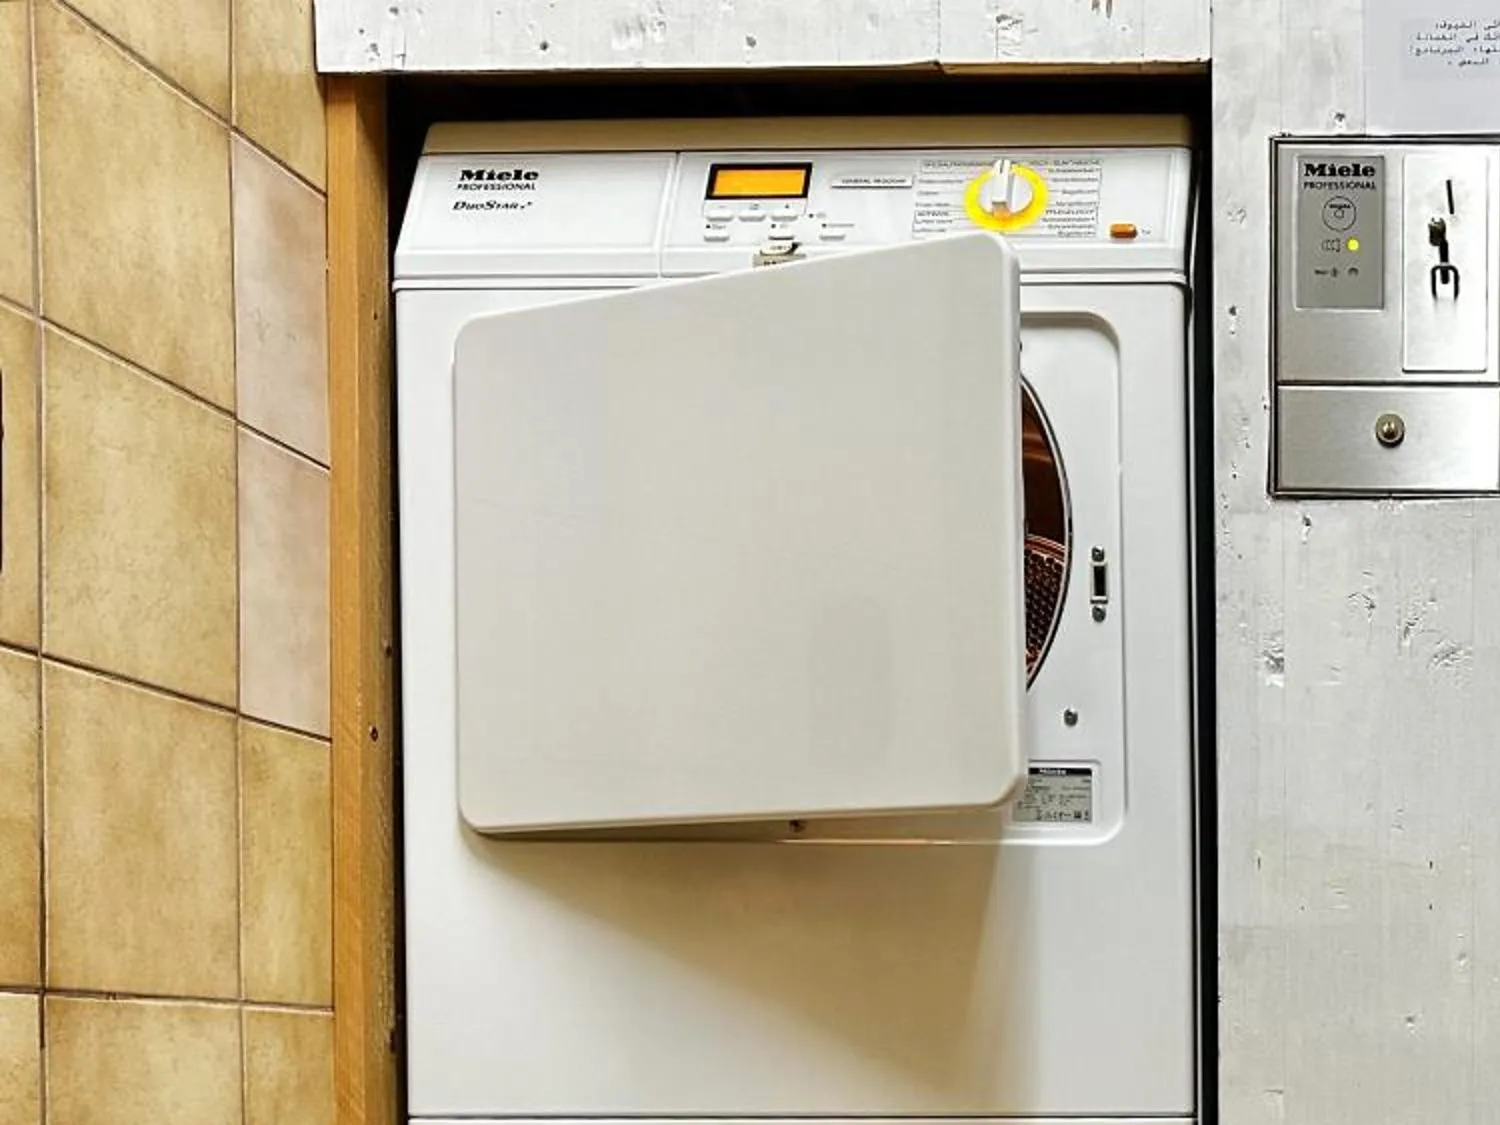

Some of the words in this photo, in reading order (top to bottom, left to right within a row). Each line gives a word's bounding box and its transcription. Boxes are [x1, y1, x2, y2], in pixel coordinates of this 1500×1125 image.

[461, 169, 539, 181] Miele
[1304, 163, 1376, 177] Miele
[457, 183, 536, 191] PROFESSIONAL
[1303, 181, 1377, 190] PROFESSIONAL
